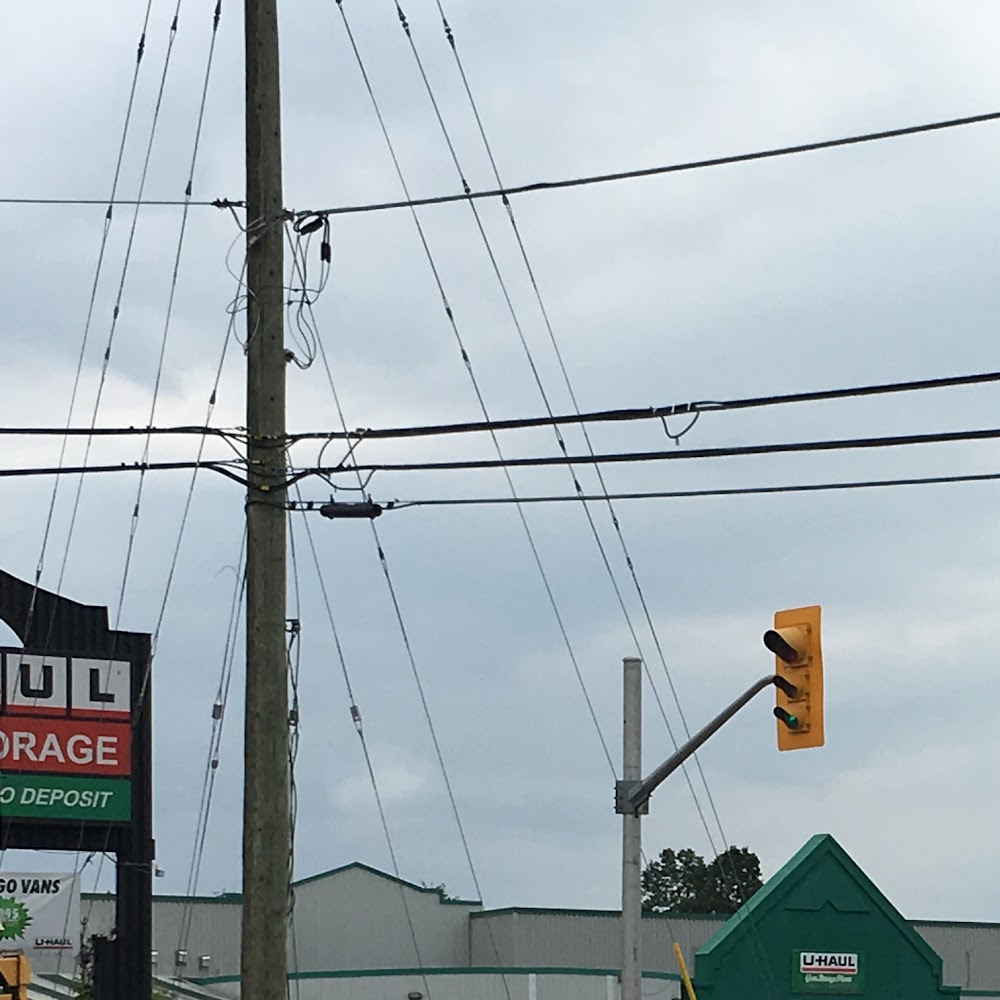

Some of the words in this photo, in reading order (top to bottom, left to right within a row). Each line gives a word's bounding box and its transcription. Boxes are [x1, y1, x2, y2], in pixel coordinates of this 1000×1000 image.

[20, 787, 113, 808] DEPOSIT
[21, 878, 61, 894] VANS
[803, 954, 856, 967] U-HAUL
